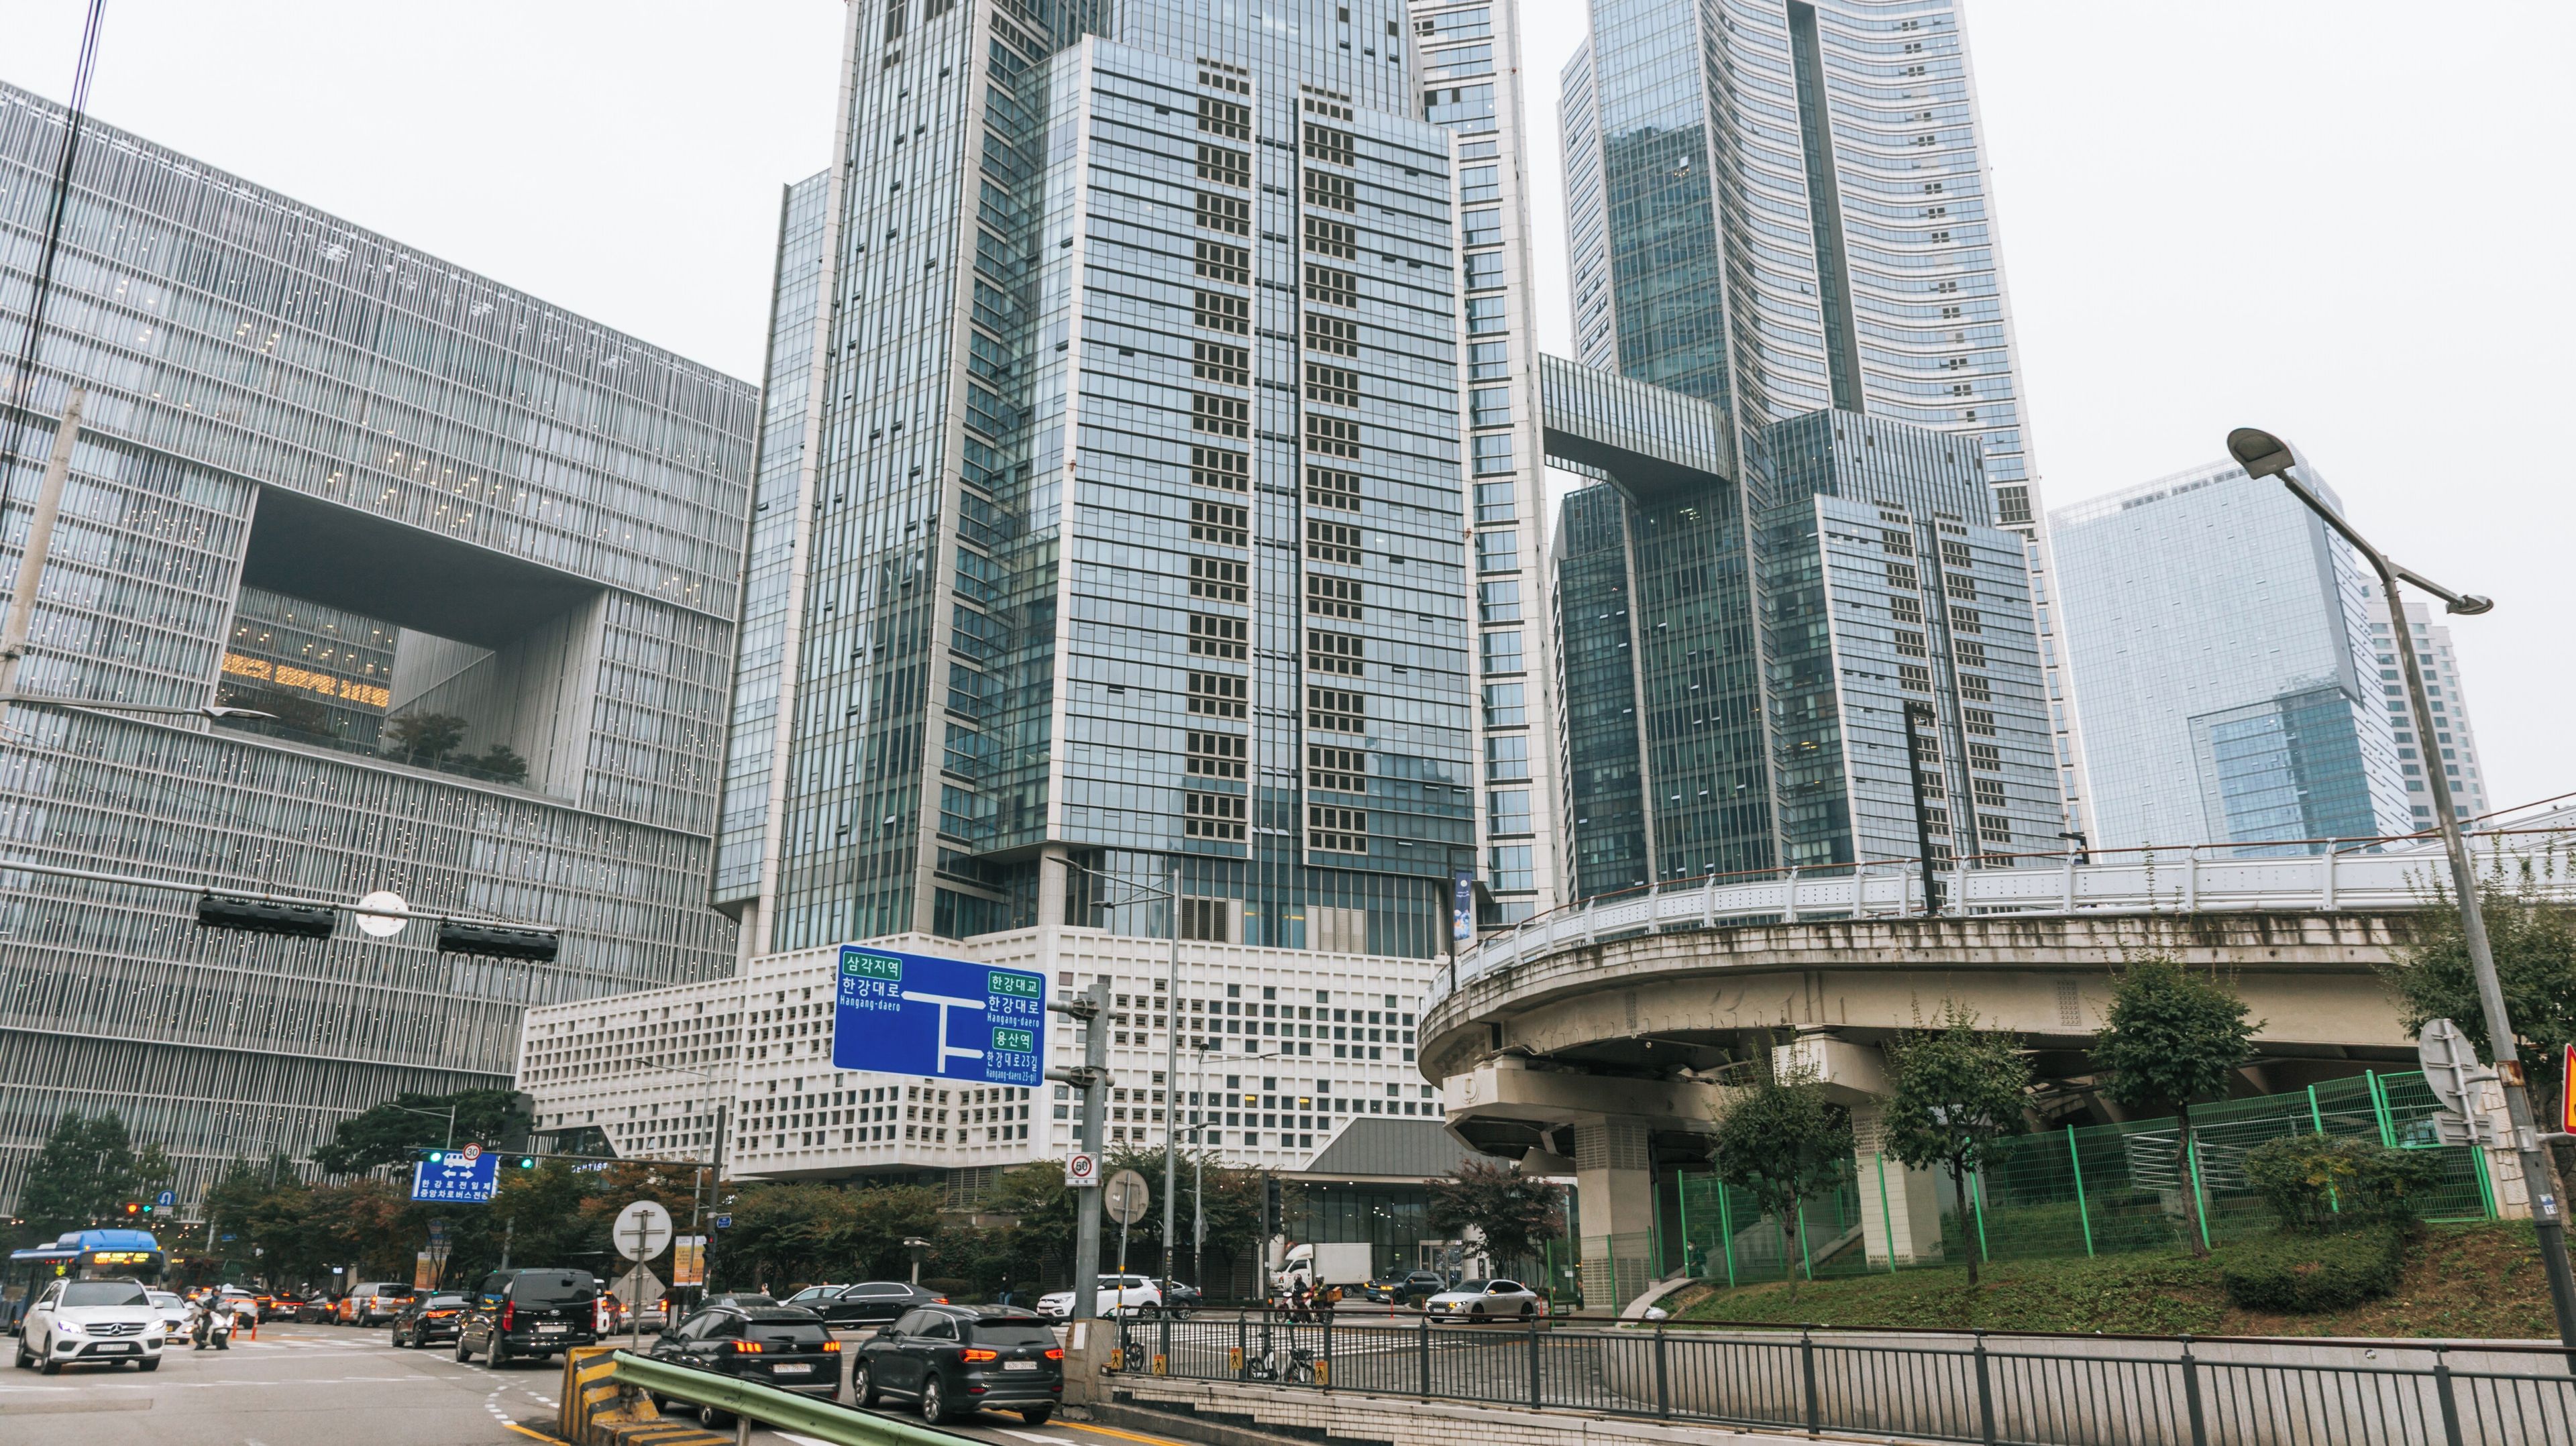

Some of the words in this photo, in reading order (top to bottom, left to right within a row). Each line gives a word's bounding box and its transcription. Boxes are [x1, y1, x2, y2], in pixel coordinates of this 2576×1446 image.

[847, 956, 898, 977] 삼각지역
[843, 977, 900, 997] 한강대로
[992, 975, 1037, 992] 한강대교
[840, 995, 900, 1011] Hangang-daero
[989, 995, 1039, 1014] 한강대로
[987, 1012, 1039, 1027] Hangang-daero
[996, 1031, 1030, 1049] 용산역
[987, 1050, 1037, 1072] 한강대로23길
[986, 1068, 1021, 1081] Hangang-daero
[1022, 1070, 1036, 1084] 23-gil
[467, 1148, 478, 1156] 30
[1076, 1161, 1087, 1171] 50
